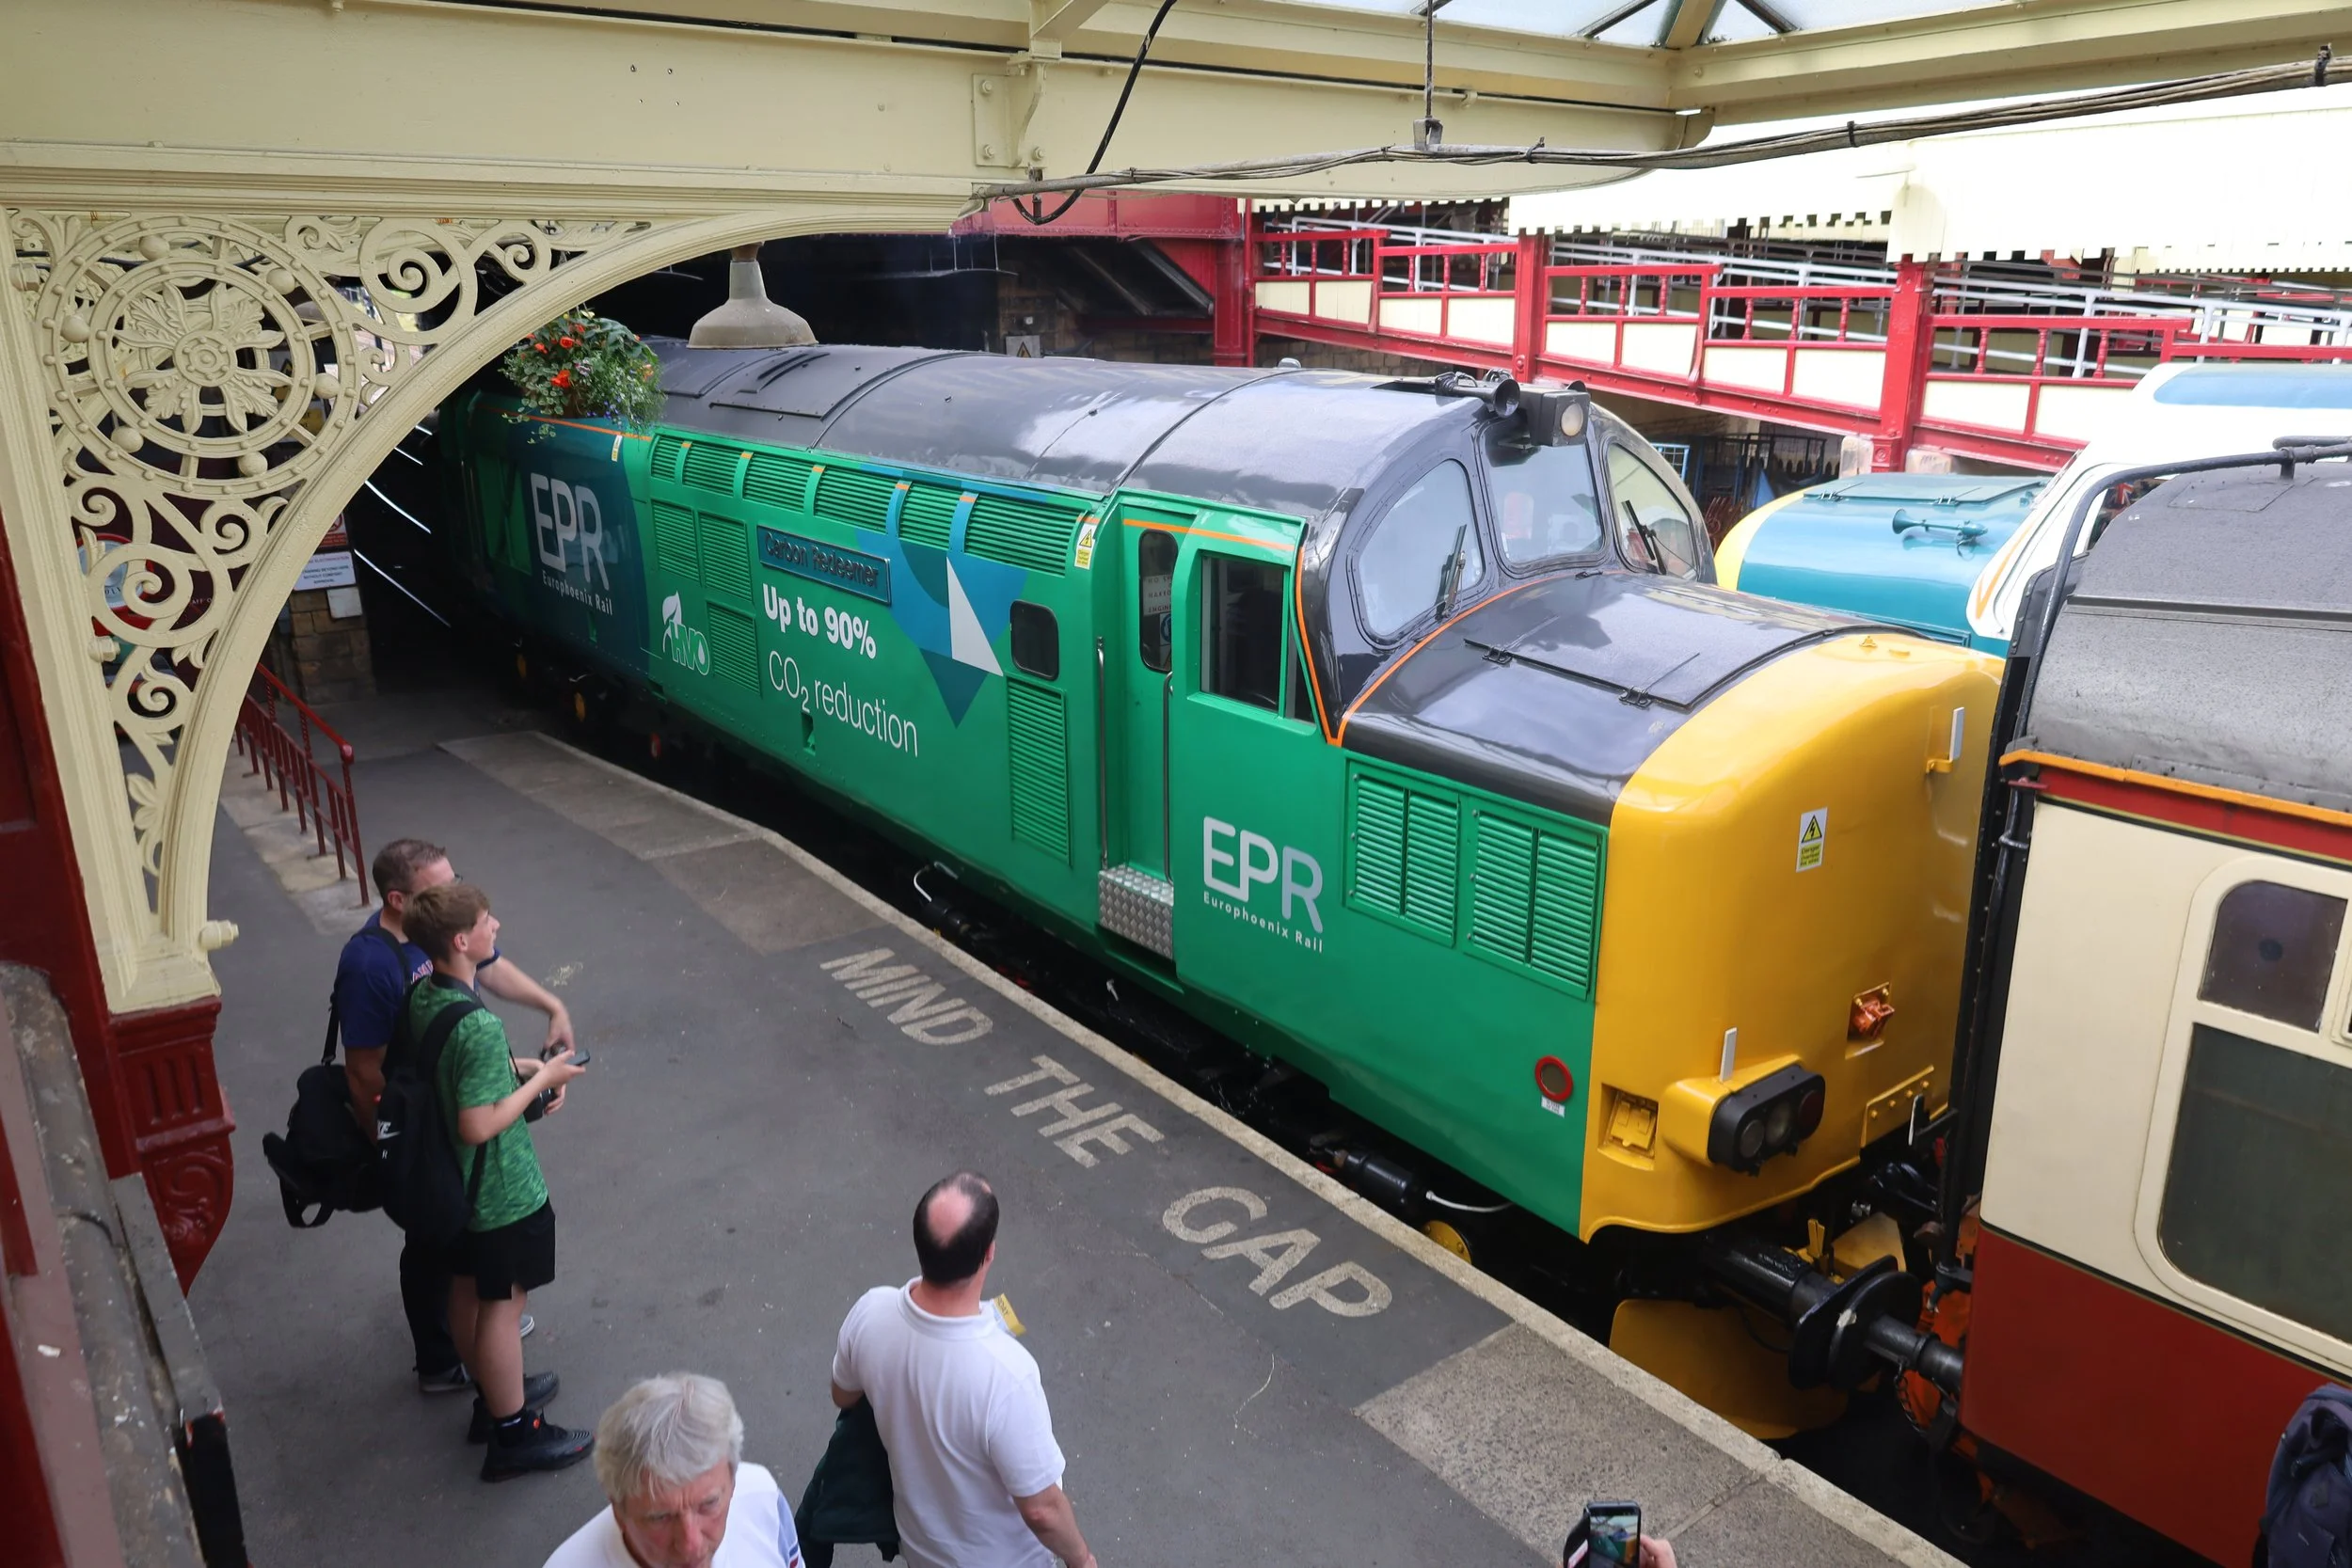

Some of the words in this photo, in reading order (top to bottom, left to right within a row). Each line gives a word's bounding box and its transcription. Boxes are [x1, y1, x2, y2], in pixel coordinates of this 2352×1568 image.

[531, 472, 610, 591] EPR
[765, 531, 808, 567] Carbon
[811, 545, 879, 589] Redeemer
[542, 569, 594, 607] Europhoenix
[596, 594, 613, 616] Rail
[762, 582, 791, 633] Up
[796, 596, 818, 636] to
[824, 606, 877, 659] 90%
[669, 619, 709, 676] HVO
[815, 679, 918, 758] reduction
[1203, 816, 1324, 934] EPR
[1203, 890, 1289, 939] Europhoenix
[1295, 929, 1323, 954] Rail
[819, 947, 994, 1046] MIND
[983, 1053, 1166, 1168] THE
[1162, 1185, 1392, 1318] GAP
